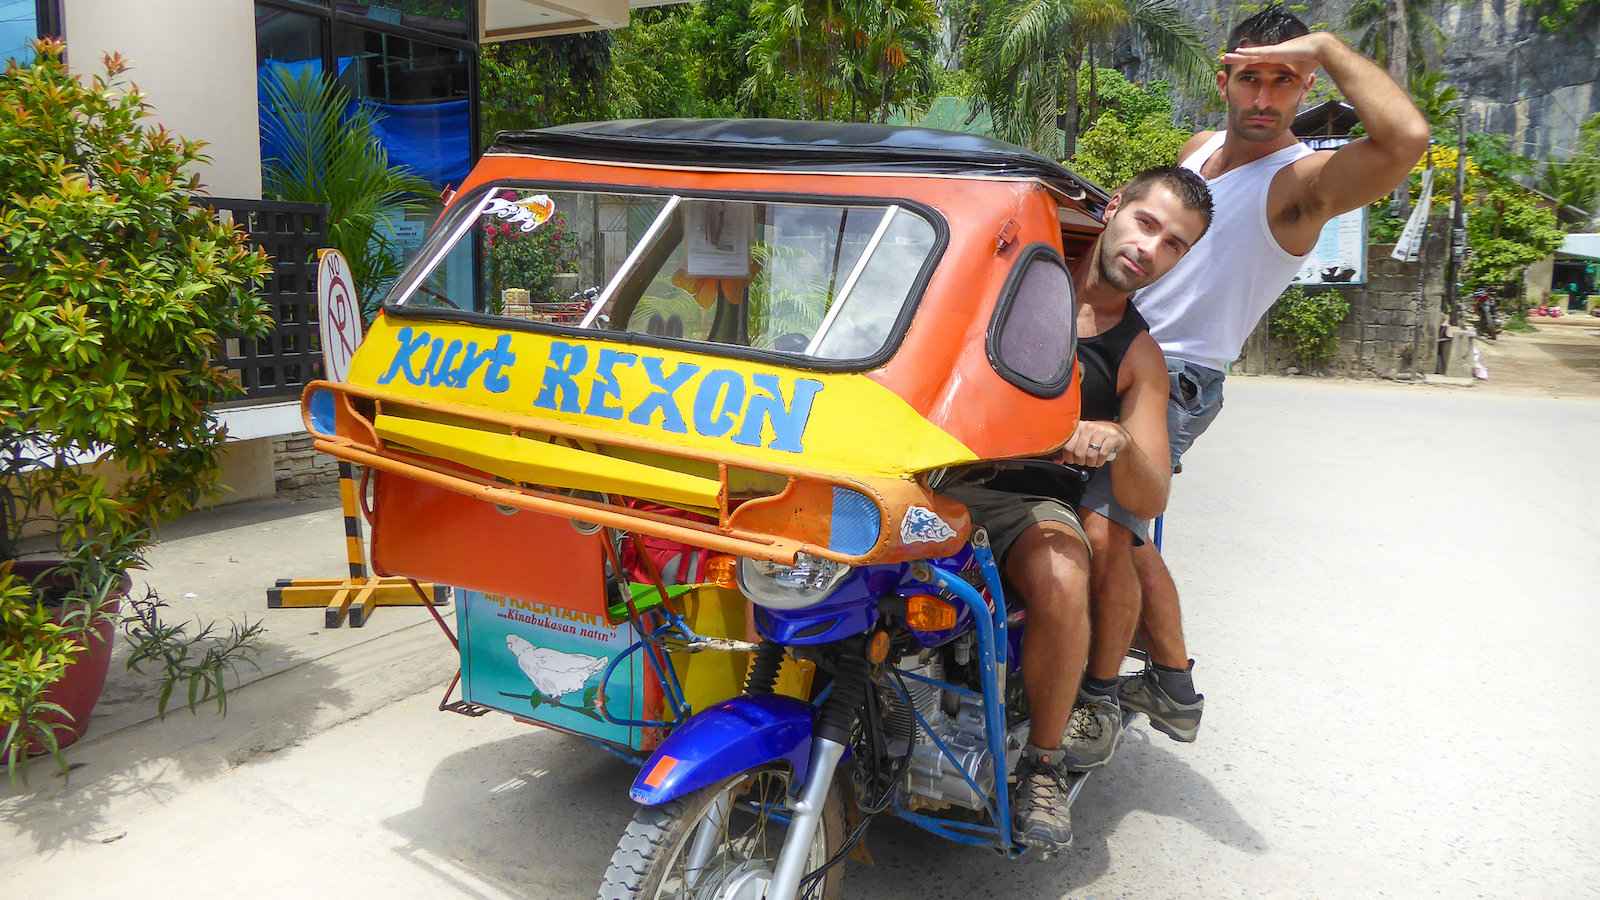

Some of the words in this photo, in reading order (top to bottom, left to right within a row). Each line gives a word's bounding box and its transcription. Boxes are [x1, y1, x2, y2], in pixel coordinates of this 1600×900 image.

[327, 254, 340, 281] NO
[377, 326, 517, 393] Kurt
[532, 341, 825, 453] REXON
